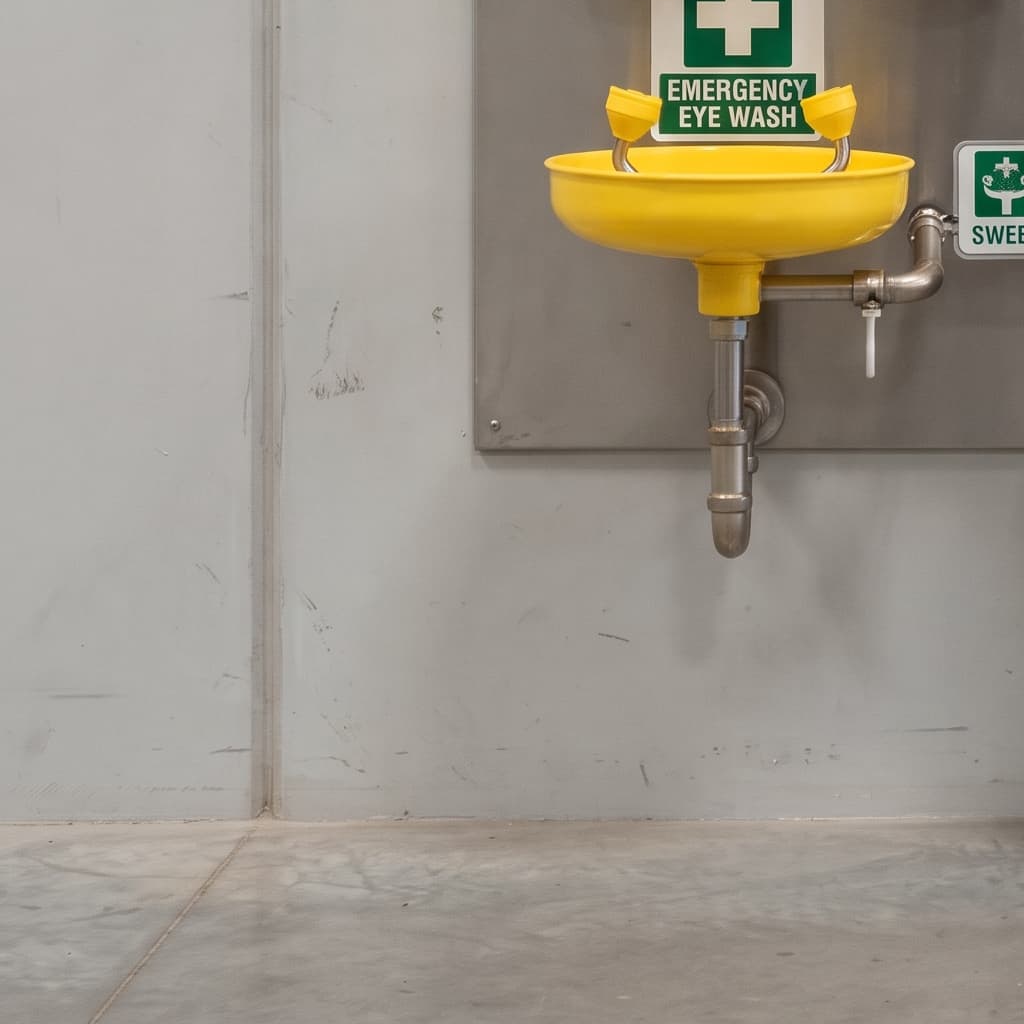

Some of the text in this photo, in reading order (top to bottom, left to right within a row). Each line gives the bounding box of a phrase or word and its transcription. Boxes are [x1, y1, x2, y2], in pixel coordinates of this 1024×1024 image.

[668, 79, 808, 102] EMERGENCY
[679, 106, 797, 128] EYE WASH
